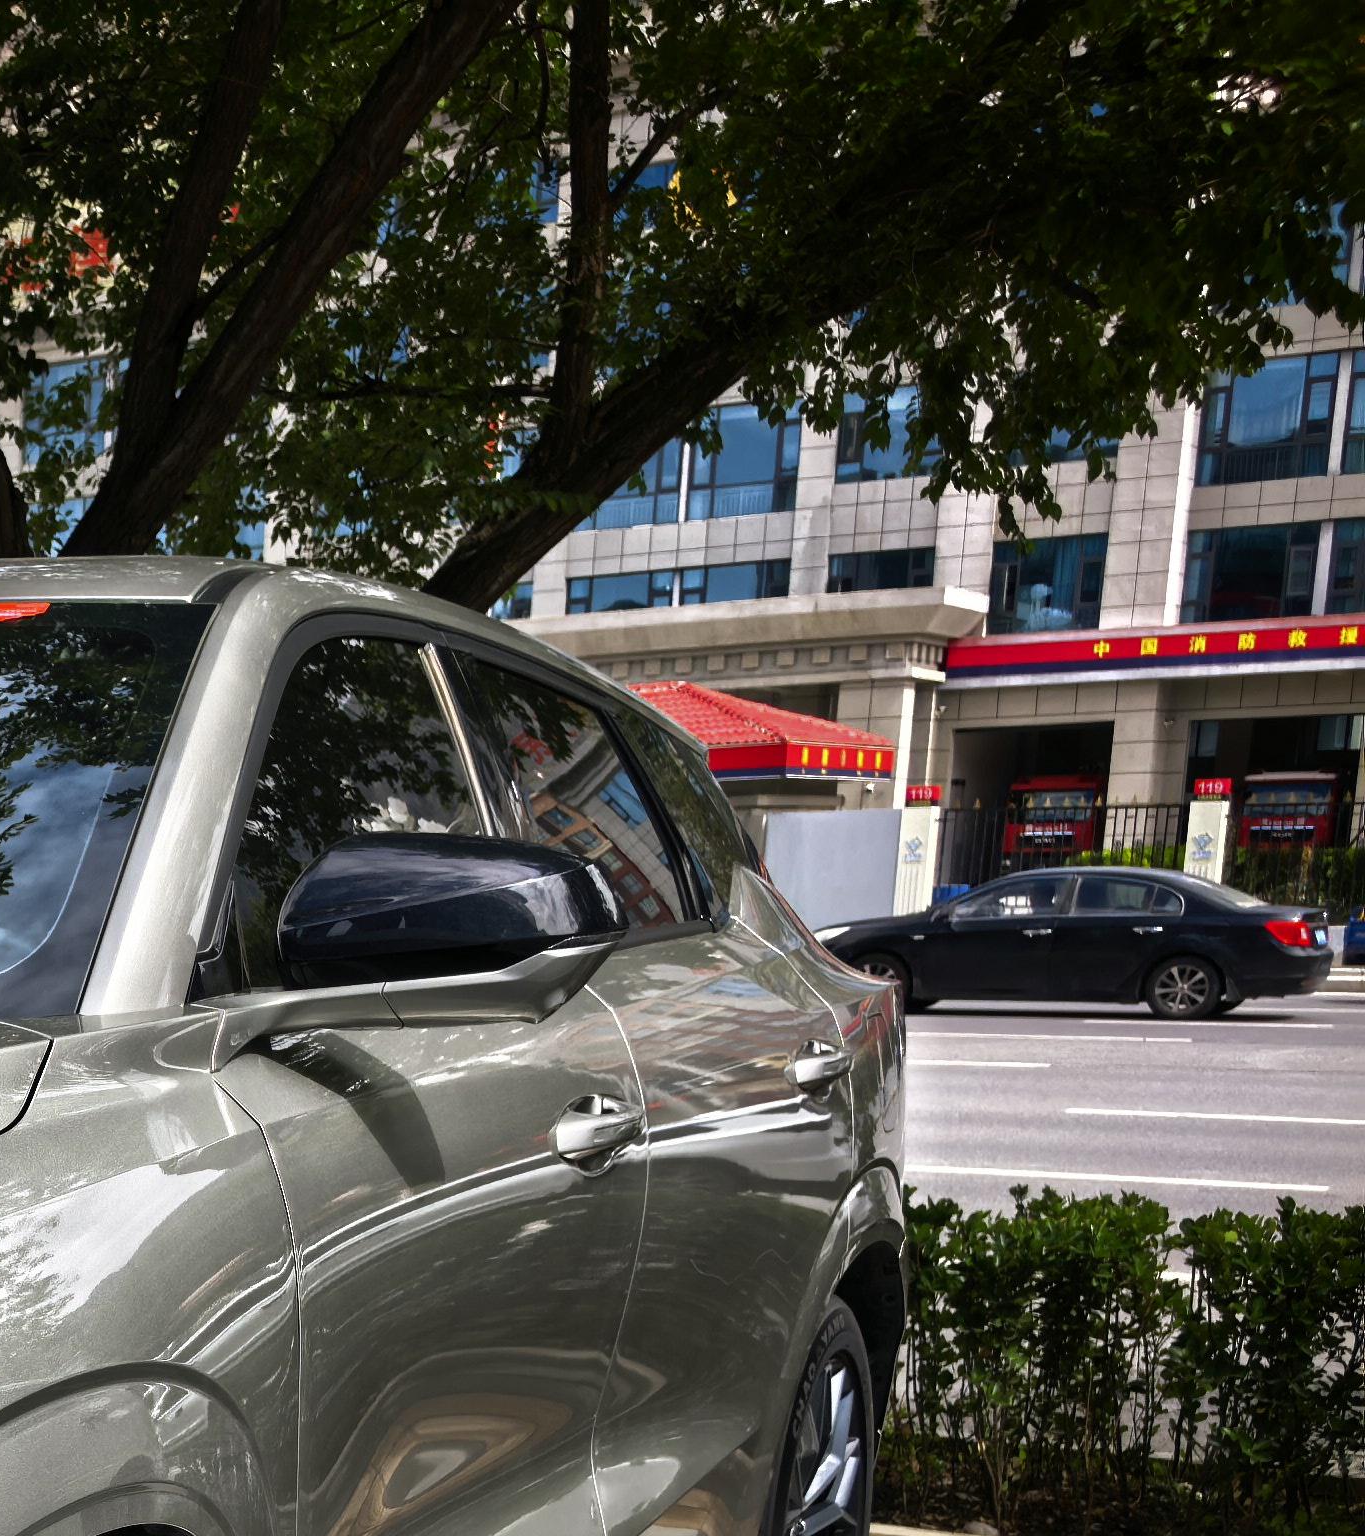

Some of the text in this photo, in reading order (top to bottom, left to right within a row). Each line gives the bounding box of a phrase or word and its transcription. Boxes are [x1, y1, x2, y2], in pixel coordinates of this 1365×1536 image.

[1093, 626, 1360, 658] 中国消防救援
[911, 787, 933, 800] 119
[1199, 781, 1223, 794] 119
